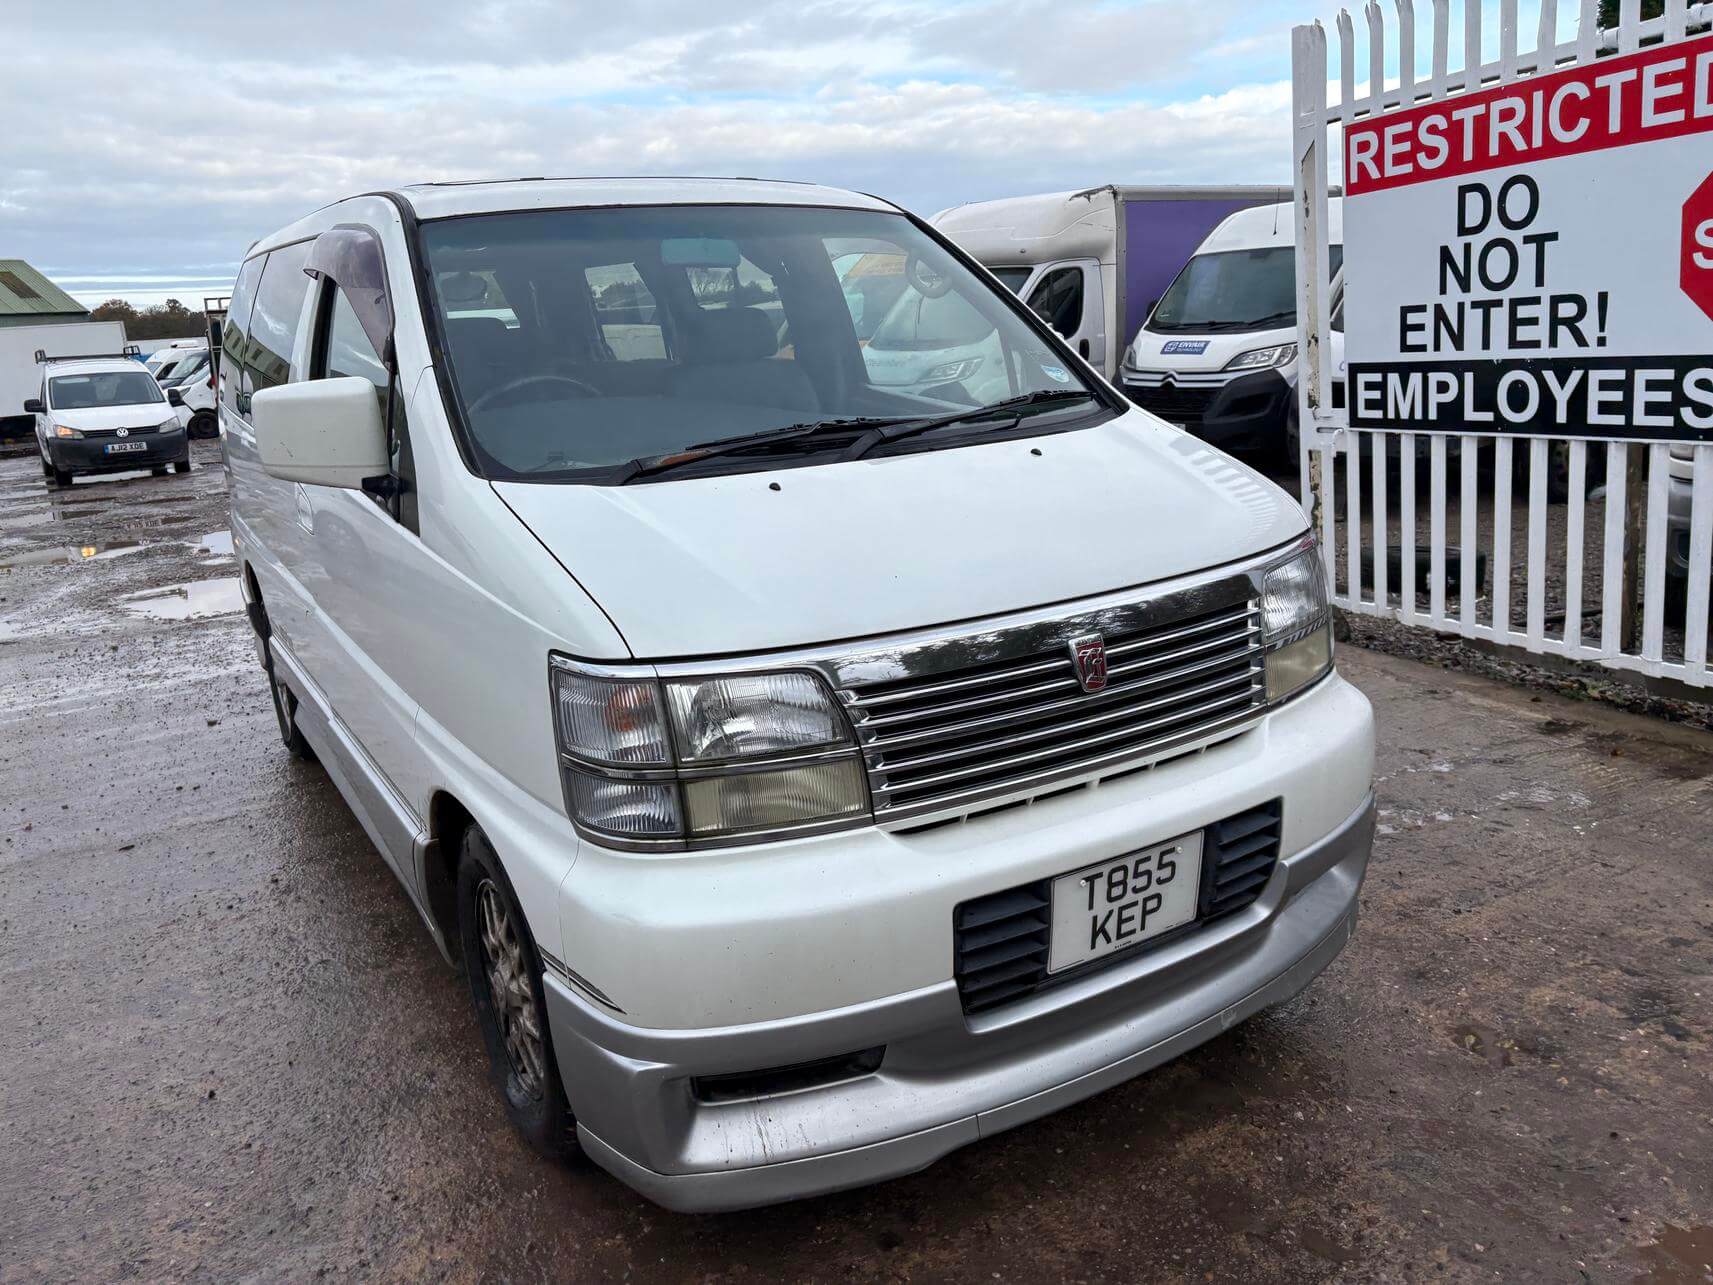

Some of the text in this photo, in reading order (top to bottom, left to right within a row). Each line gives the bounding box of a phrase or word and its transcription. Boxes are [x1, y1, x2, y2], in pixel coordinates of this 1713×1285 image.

[1457, 174, 1540, 237] DO
[1439, 232, 1559, 295] NOT
[1400, 291, 1609, 353] ENTER!
[1356, 367, 1713, 429] EMPLOYEES
[1082, 847, 1176, 911] T855
[1090, 892, 1163, 950] KEP
